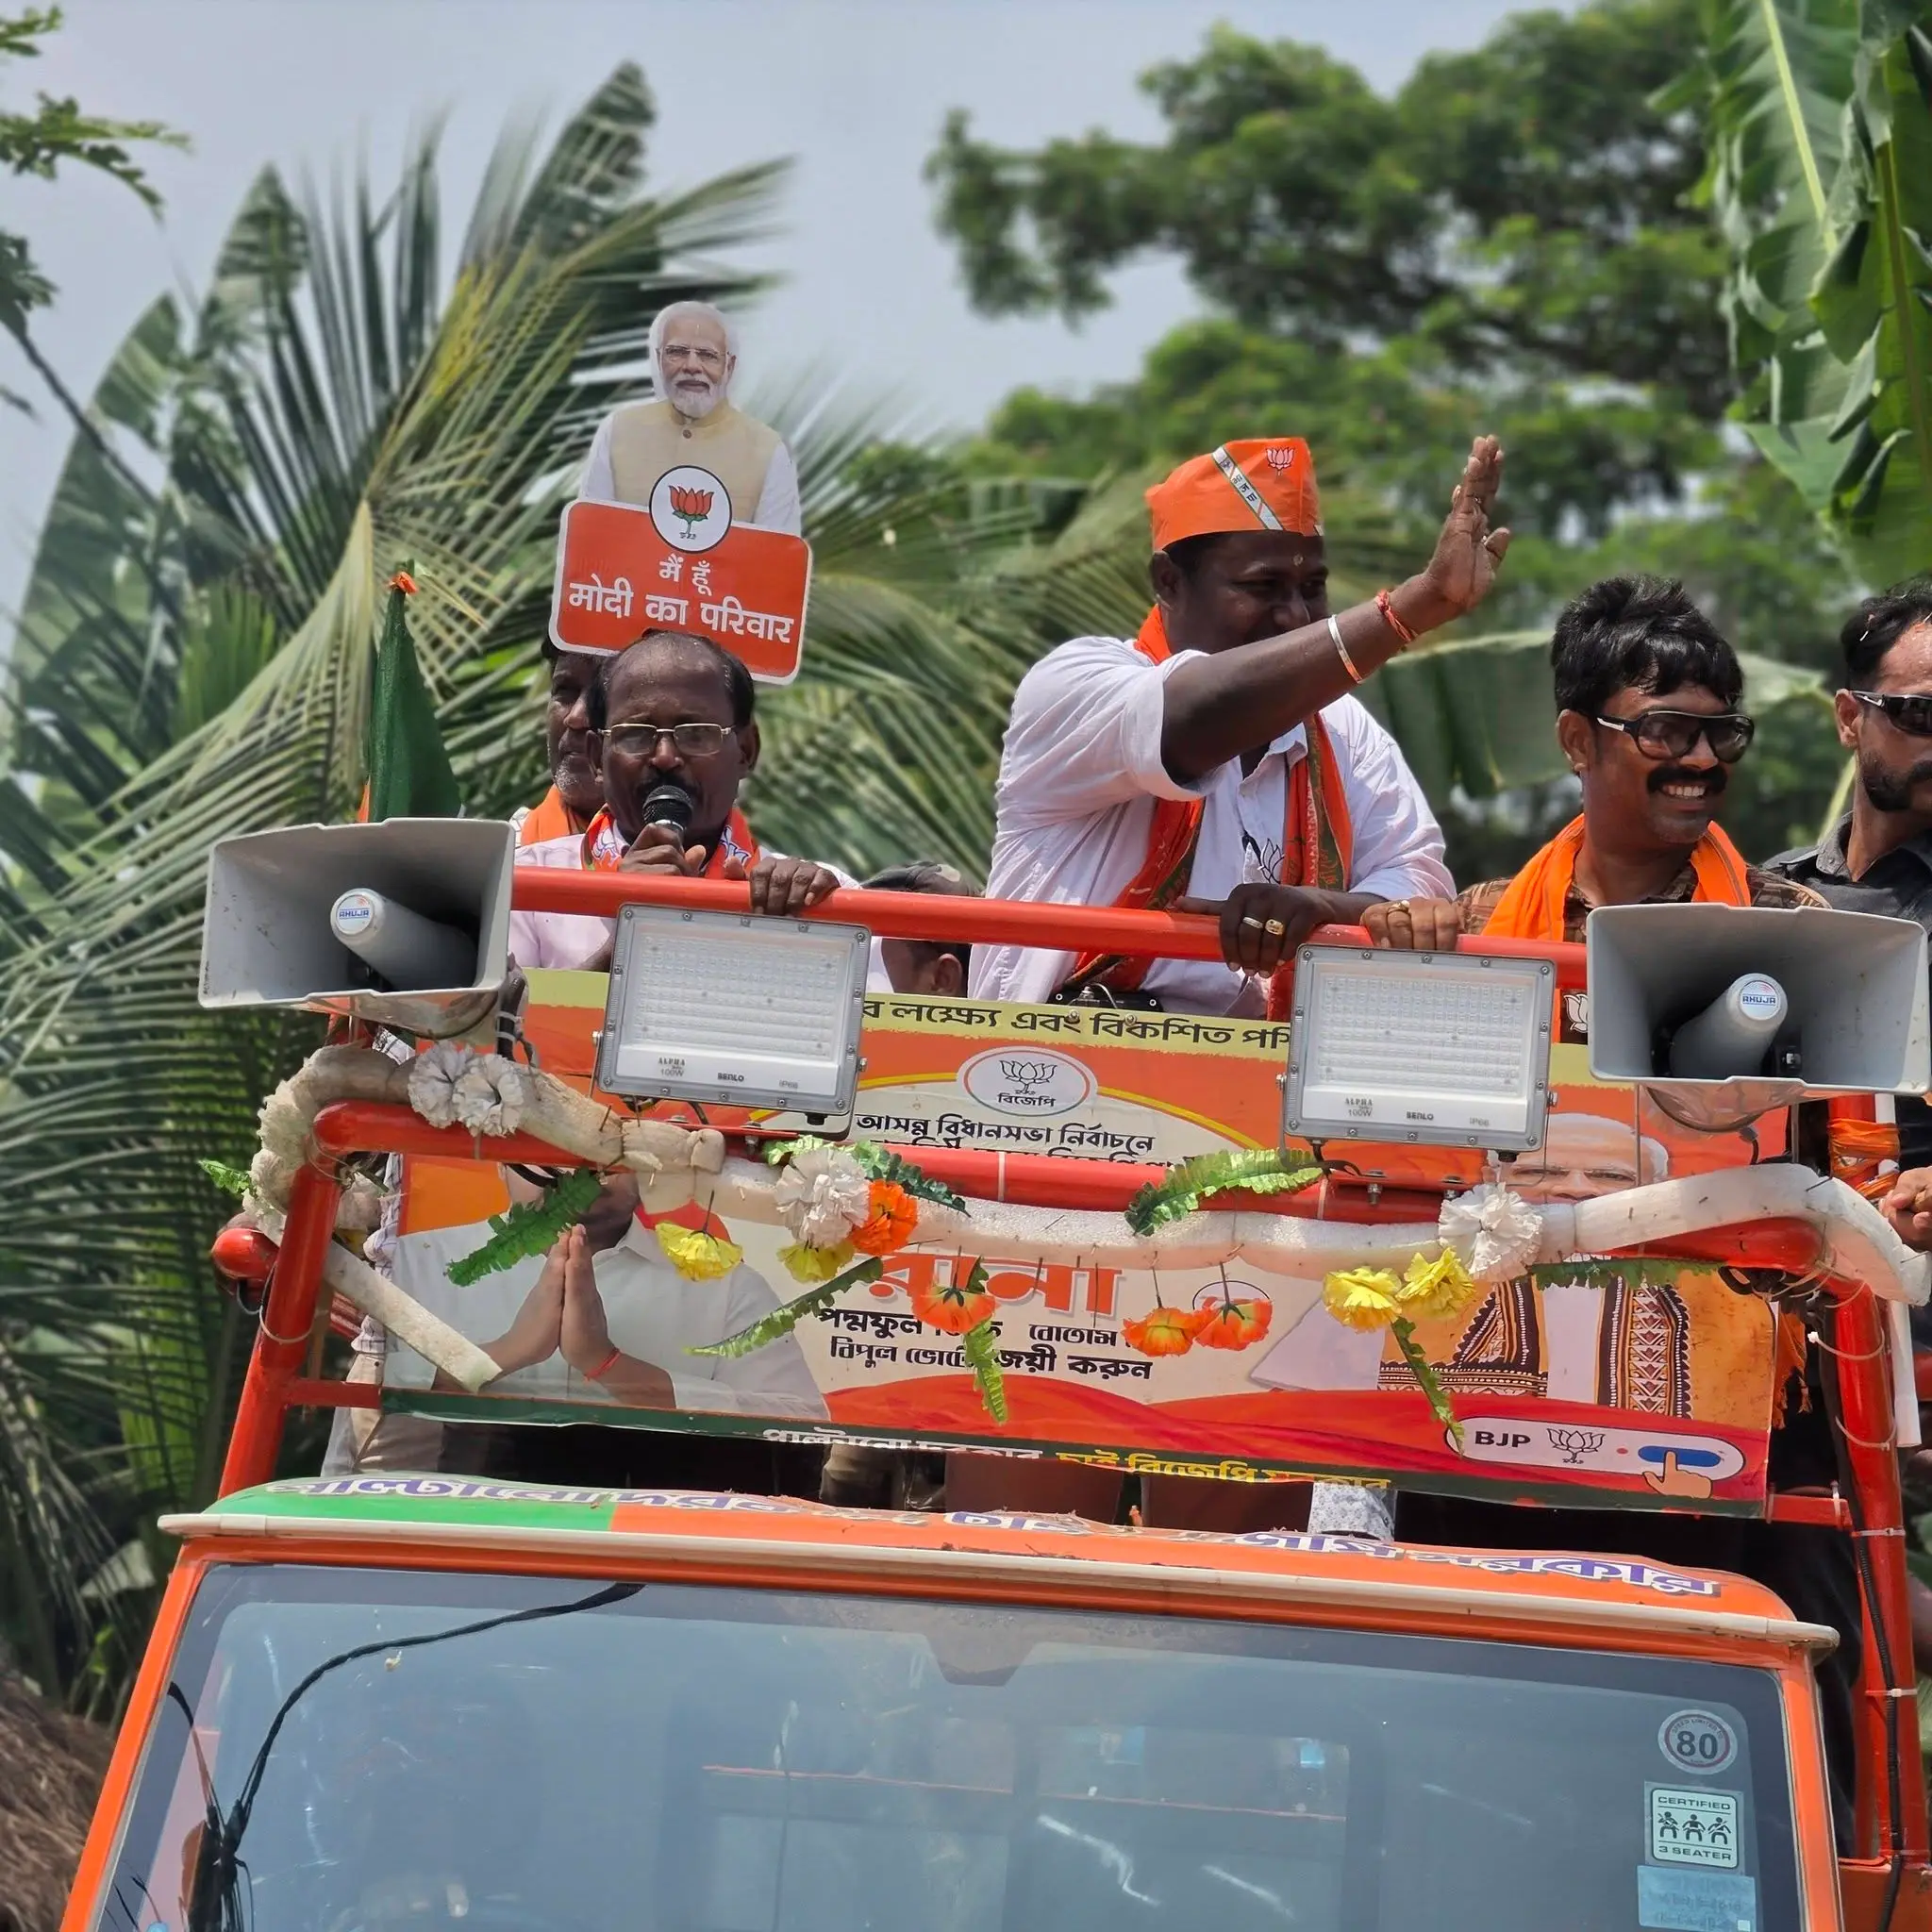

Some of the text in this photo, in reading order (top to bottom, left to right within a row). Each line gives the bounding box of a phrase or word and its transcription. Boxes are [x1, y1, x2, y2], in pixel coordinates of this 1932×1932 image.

[659, 554, 712, 596] मैं हूँ
[569, 574, 794, 643] मोदी का परिवार
[1742, 995, 1775, 1004] AHUJA
[1011, 1012, 1081, 1034] এবং
[1090, 1012, 1235, 1044] বিকশিত
[997, 1092, 1056, 1107] বিজেপি
[855, 1114, 931, 1138] আসন্ন
[937, 1113, 1051, 1143] বিধানসভা
[1058, 1123, 1157, 1152] নির্বাচনে
[1029, 1324, 1118, 1346] বোতাম
[831, 1336, 898, 1368] বিপুল
[994, 1343, 1057, 1373] জয়ী
[1067, 1356, 1153, 1379] করুন
[1474, 1431, 1531, 1448] BJP
[1126, 1453, 1258, 1482] বিজেপি
[1677, 1730, 1718, 1759] 80
[1657, 1796, 1731, 1810] CERTIFIED
[1671, 1846, 1732, 1860] SEATER
